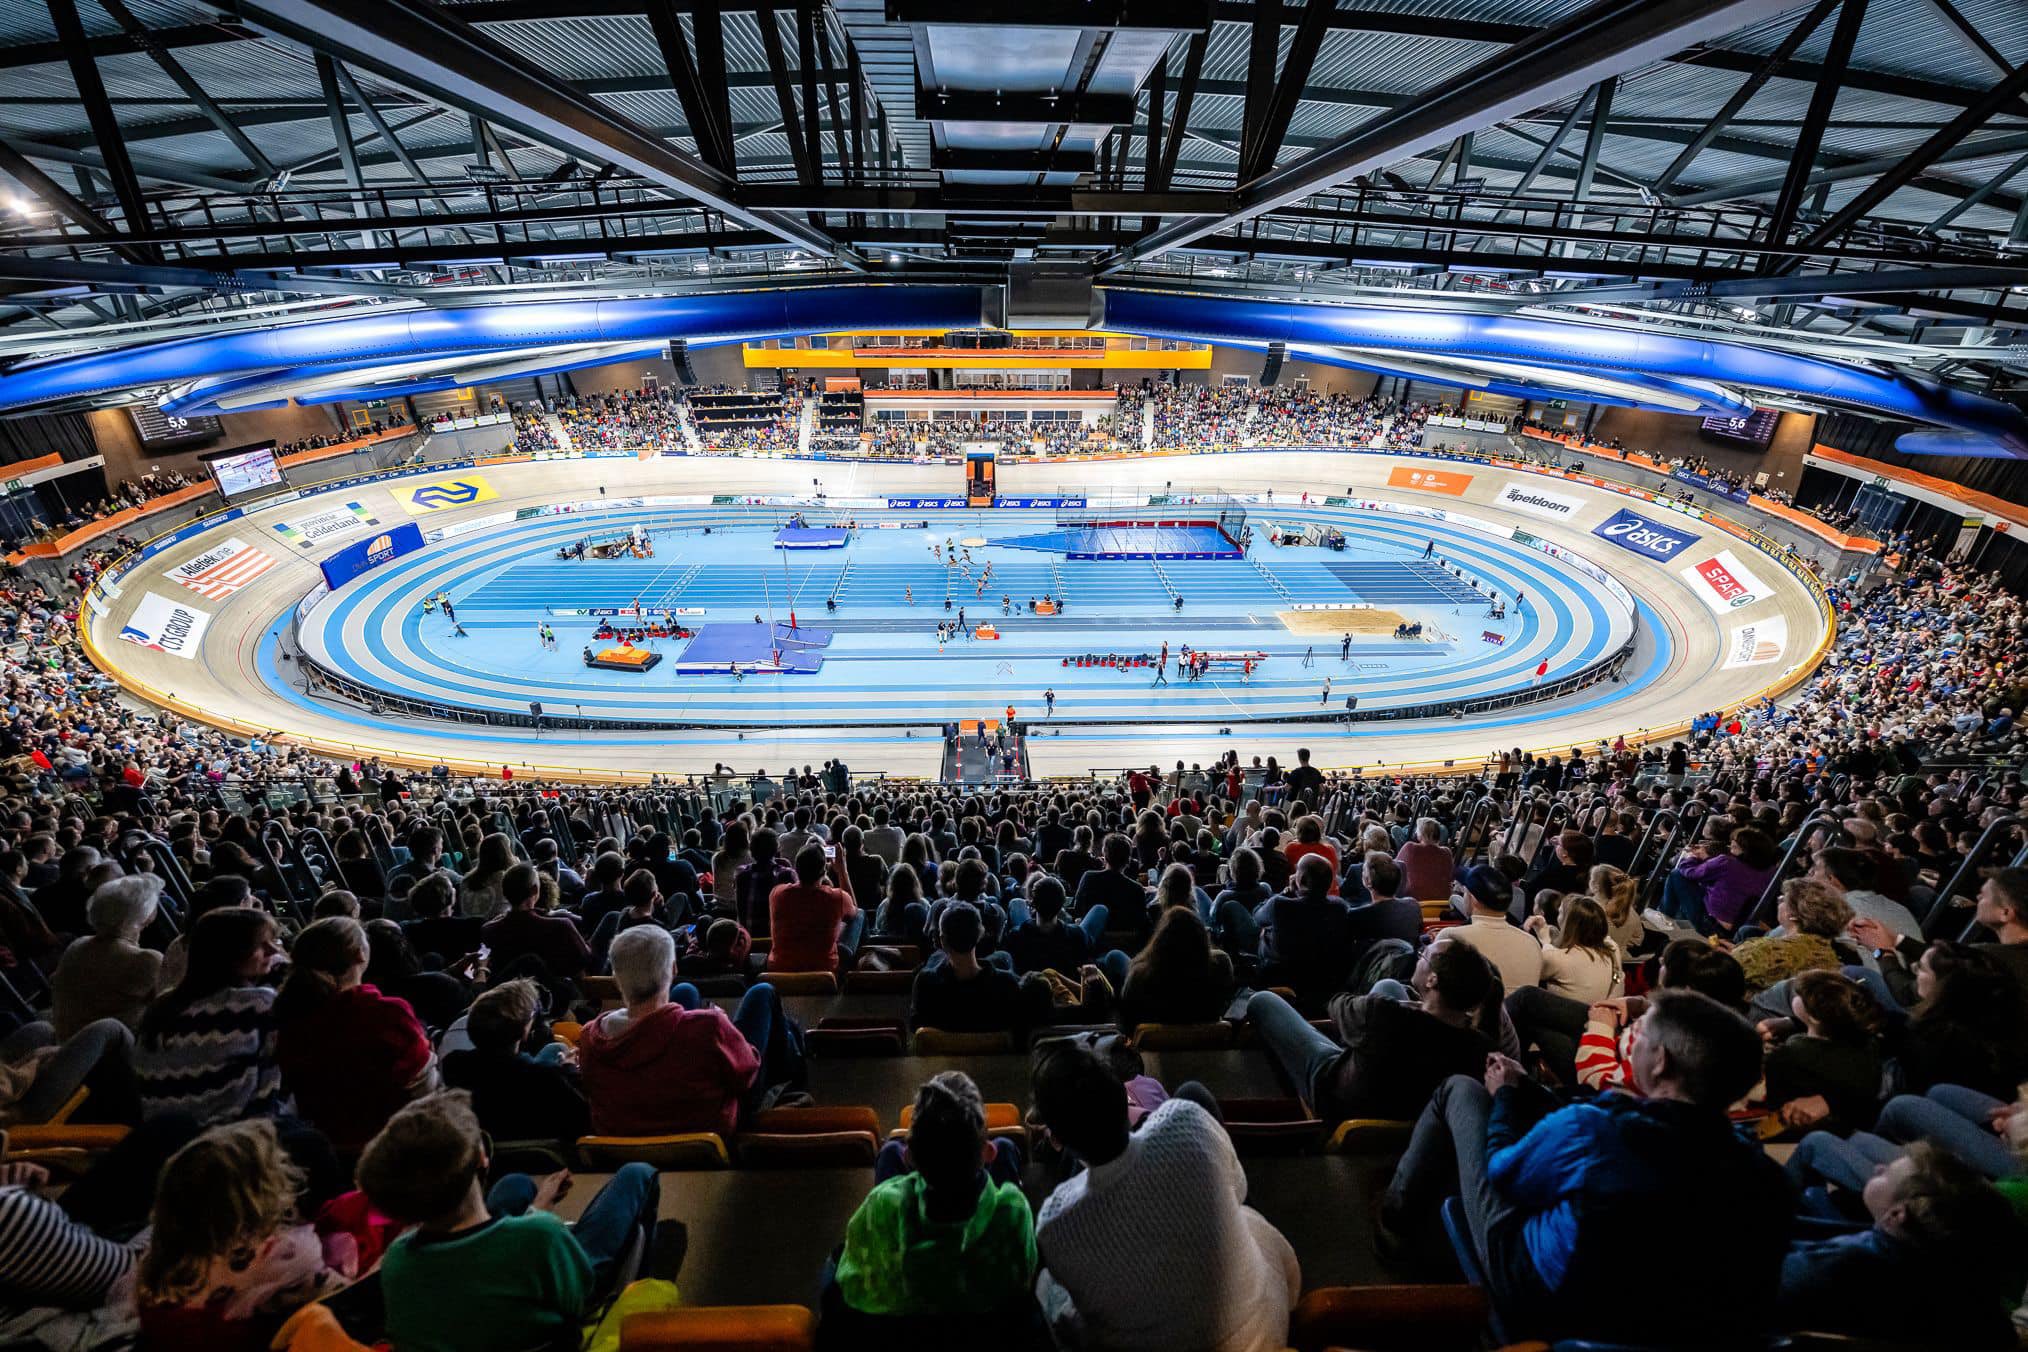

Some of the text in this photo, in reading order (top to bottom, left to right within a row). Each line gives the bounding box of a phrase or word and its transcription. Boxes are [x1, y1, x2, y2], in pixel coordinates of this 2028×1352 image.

[168, 416, 188, 430] 5,6
[1729, 417, 1747, 430] 5,6
[1506, 492, 1570, 513] apeldoorn
[305, 516, 360, 539] Gelderland
[1627, 528, 1682, 553] asics
[179, 546, 234, 577] Atletiekunie
[368, 548, 394, 565] SPORT
[1705, 567, 1742, 599] SPAR
[158, 608, 195, 650] CTS GROUP
